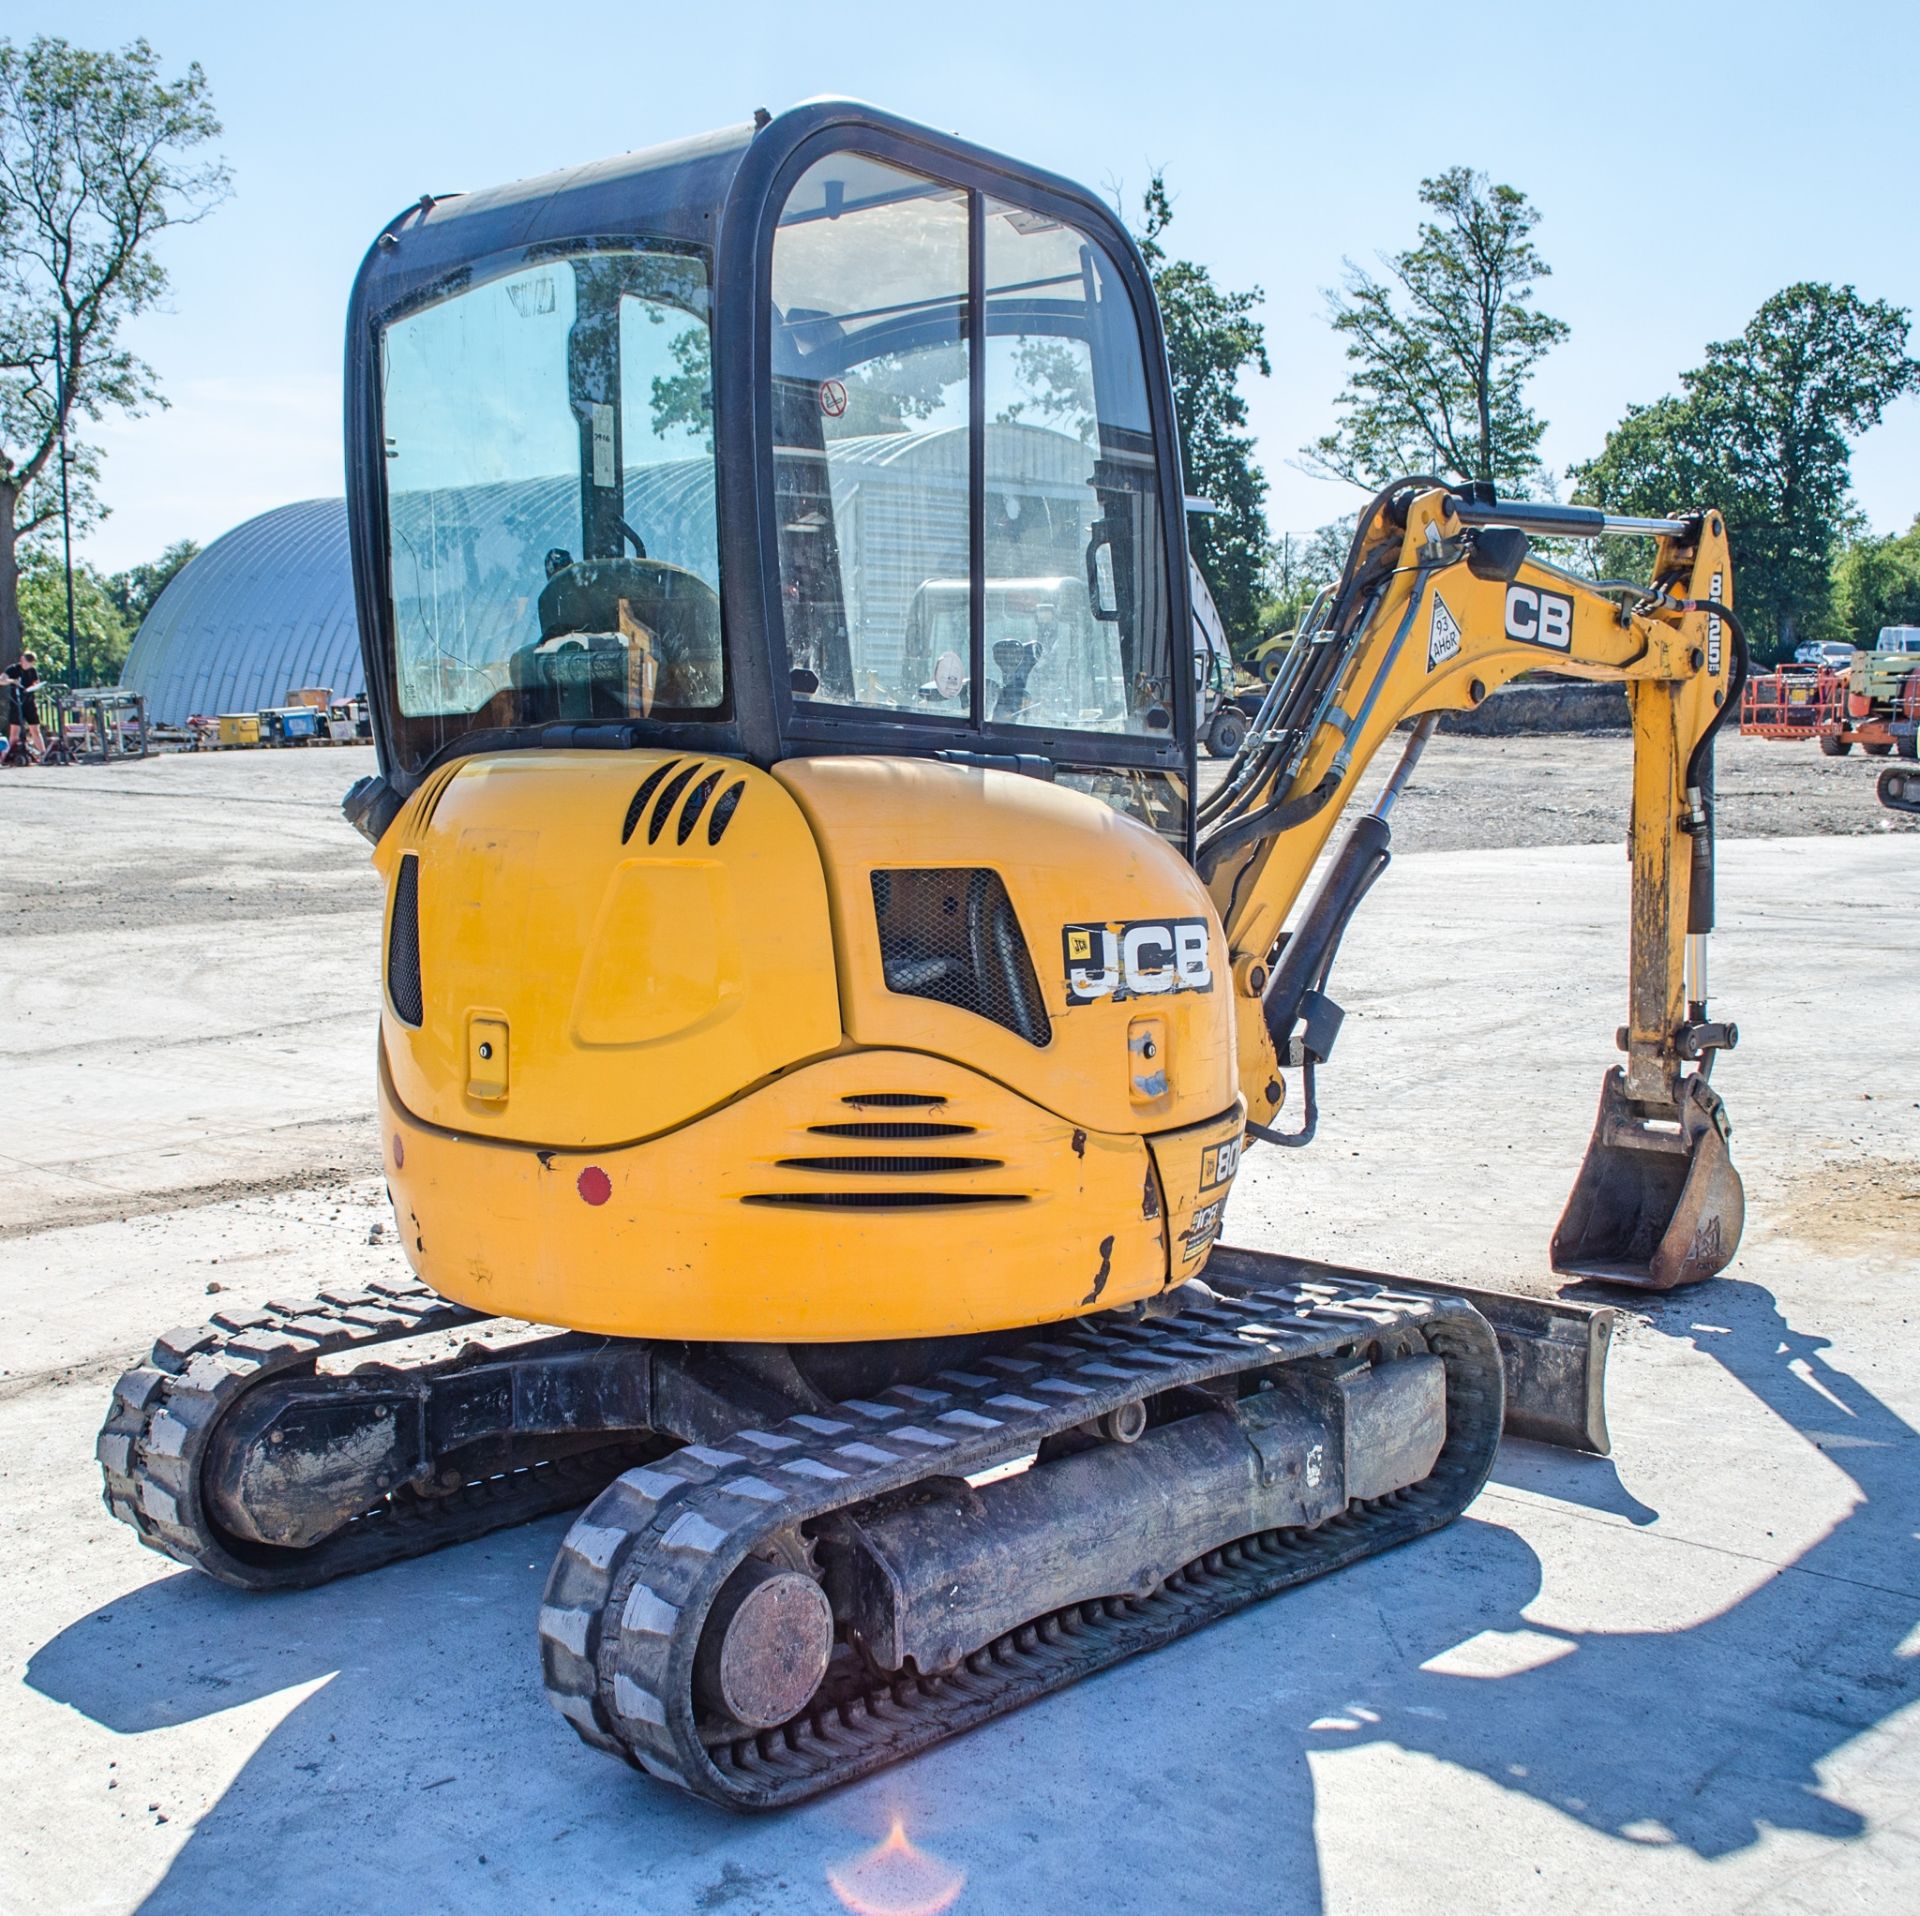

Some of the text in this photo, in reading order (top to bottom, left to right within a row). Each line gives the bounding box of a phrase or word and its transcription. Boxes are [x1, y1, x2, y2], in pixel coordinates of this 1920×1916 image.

[1436, 617, 1449, 636] 93
[1505, 586, 1571, 648] CB
[1433, 631, 1458, 658] AH6R
[1070, 925, 1211, 998] JCB
